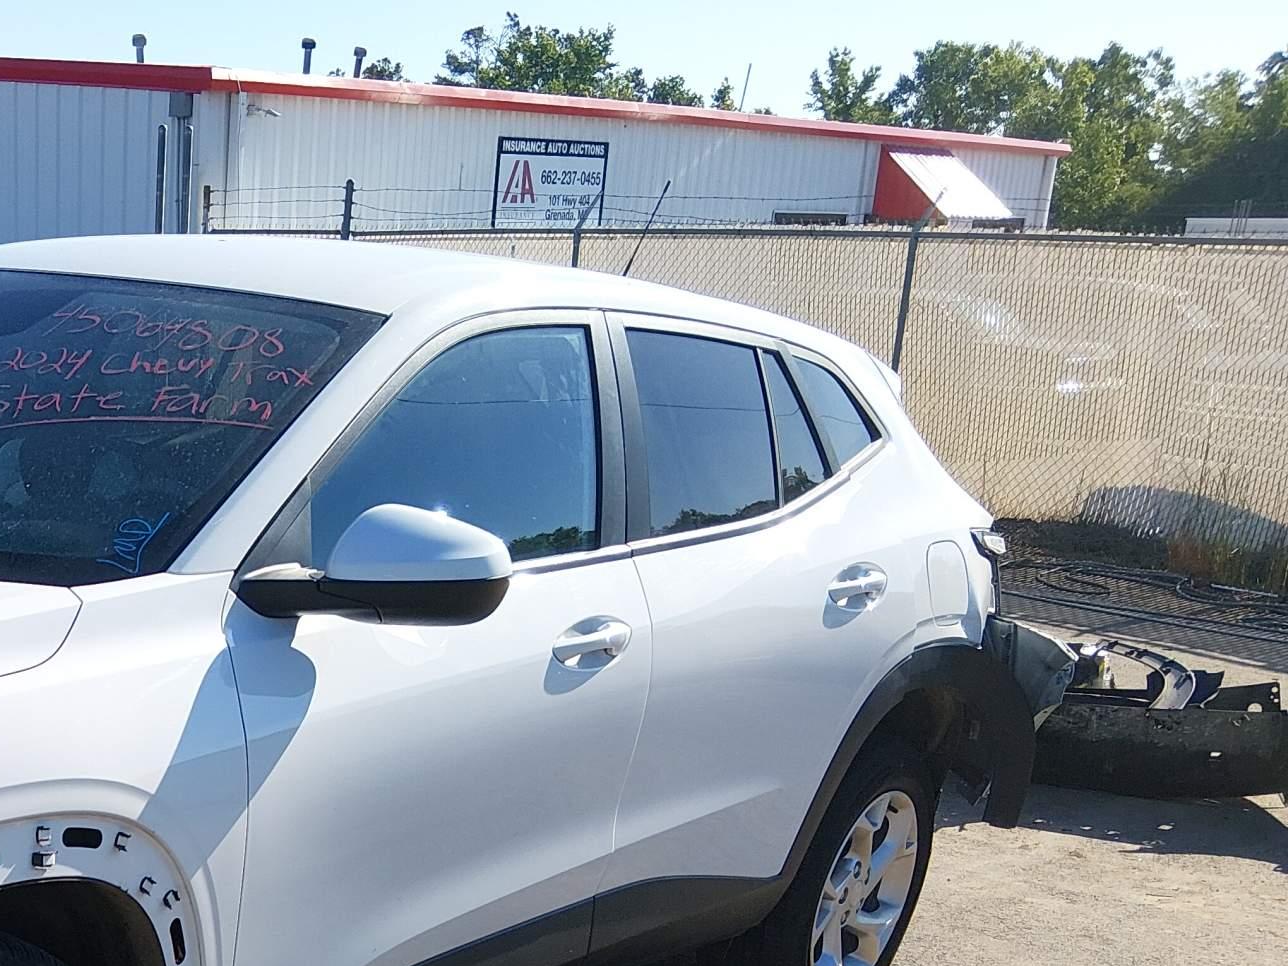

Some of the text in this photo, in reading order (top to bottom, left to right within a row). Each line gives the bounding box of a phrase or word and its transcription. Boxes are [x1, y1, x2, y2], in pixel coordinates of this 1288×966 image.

[502, 140, 605, 156] INSURANCE AUTO AUCTIONS
[540, 169, 601, 186] 662-237-0455
[562, 194, 577, 209] Hwy
[42, 303, 285, 357] 45064808
[100, 351, 215, 379] Chevy
[227, 360, 314, 388] Trax
[151, 383, 273, 421] Farm
